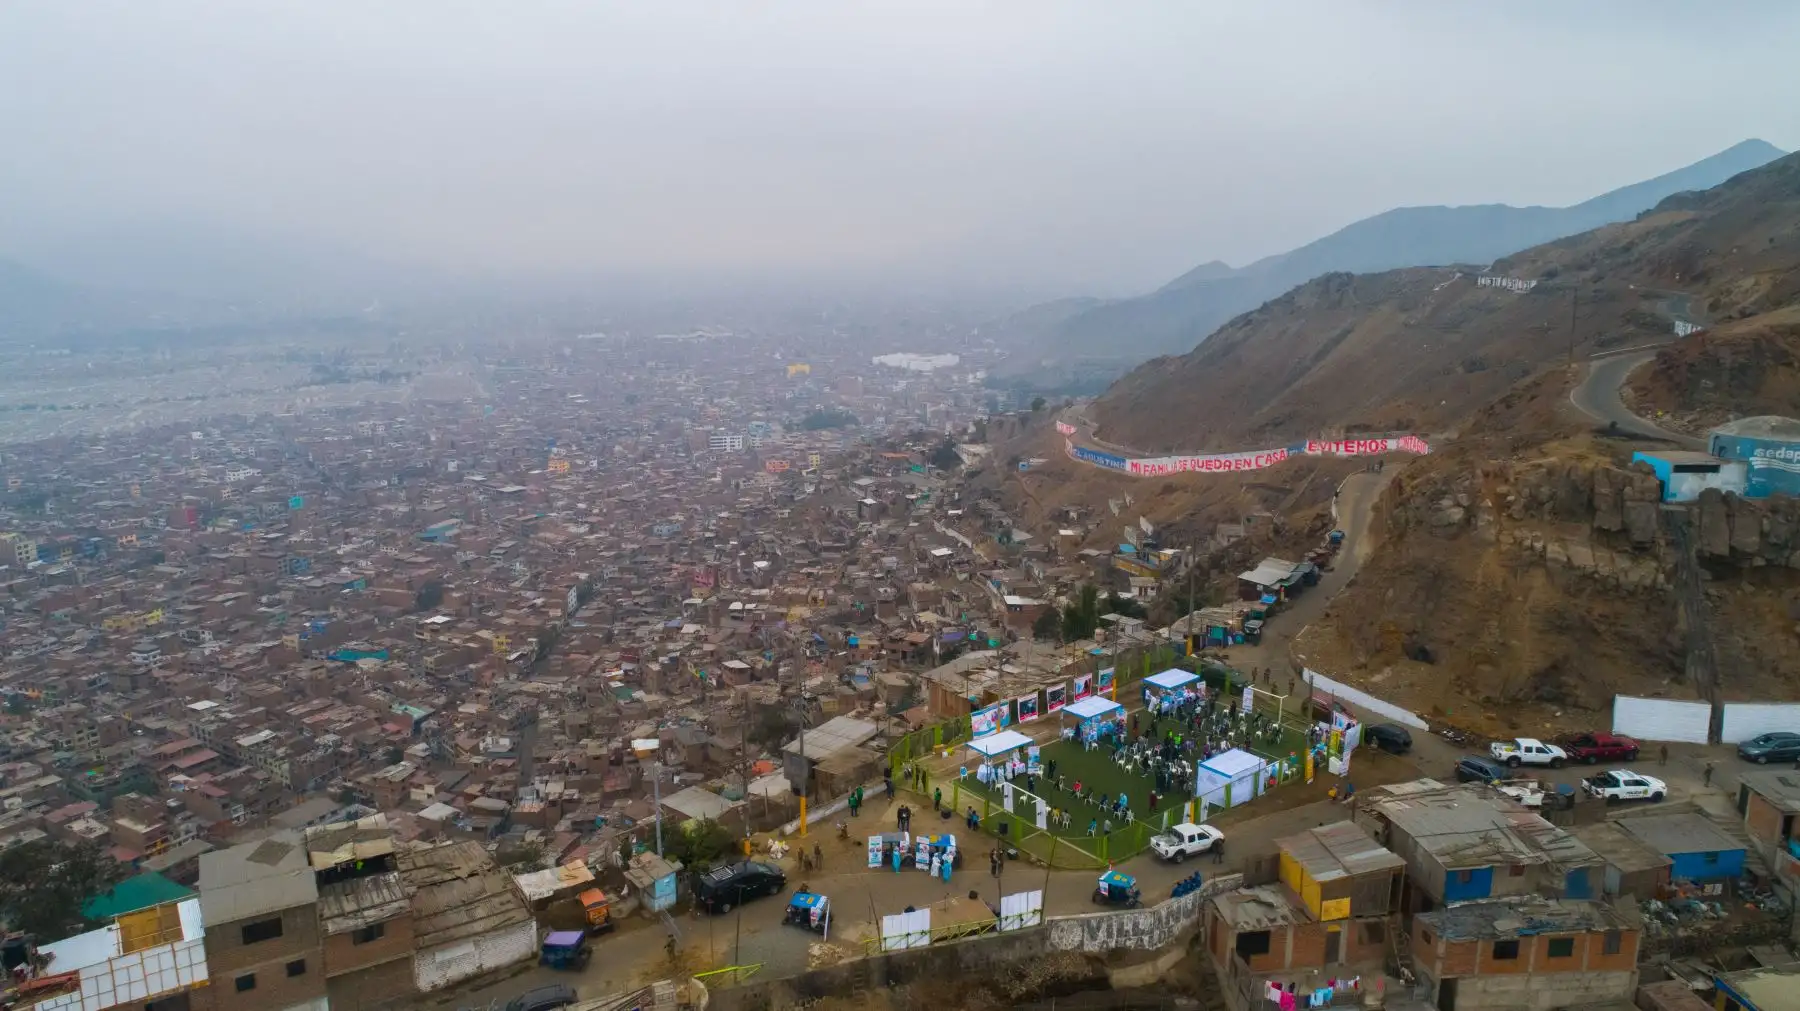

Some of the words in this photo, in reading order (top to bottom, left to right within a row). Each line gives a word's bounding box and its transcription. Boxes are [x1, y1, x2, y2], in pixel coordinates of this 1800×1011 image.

[1308, 439, 1388, 454] EVITEMOS
[1131, 461, 1140, 473] MI
[1178, 459, 1187, 472] SE
[1190, 458, 1232, 472] QUEDA
[1234, 457, 1252, 470] EN
[1255, 448, 1286, 469] CASA
